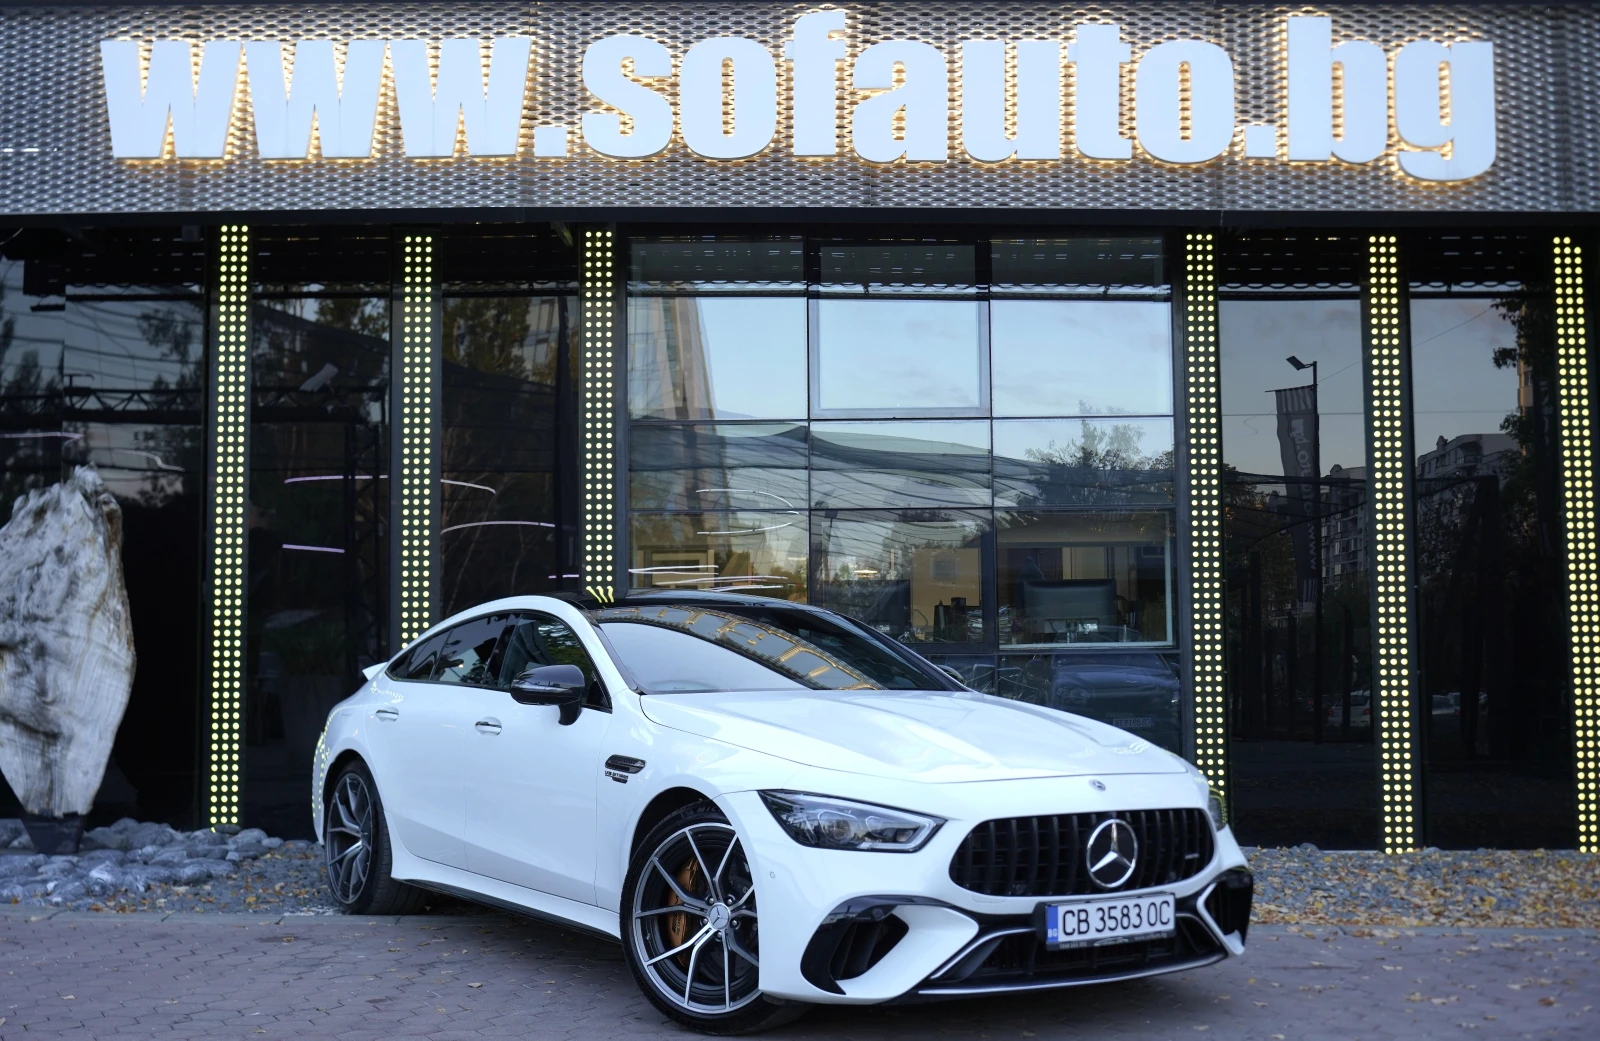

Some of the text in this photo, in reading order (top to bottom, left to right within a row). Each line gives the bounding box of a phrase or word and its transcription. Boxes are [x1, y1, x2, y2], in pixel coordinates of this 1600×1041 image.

[100, 8, 1496, 182] www.sofauto.bg
[1047, 928, 1058, 938] BG
[1062, 901, 1170, 936] CB 3583 OC
